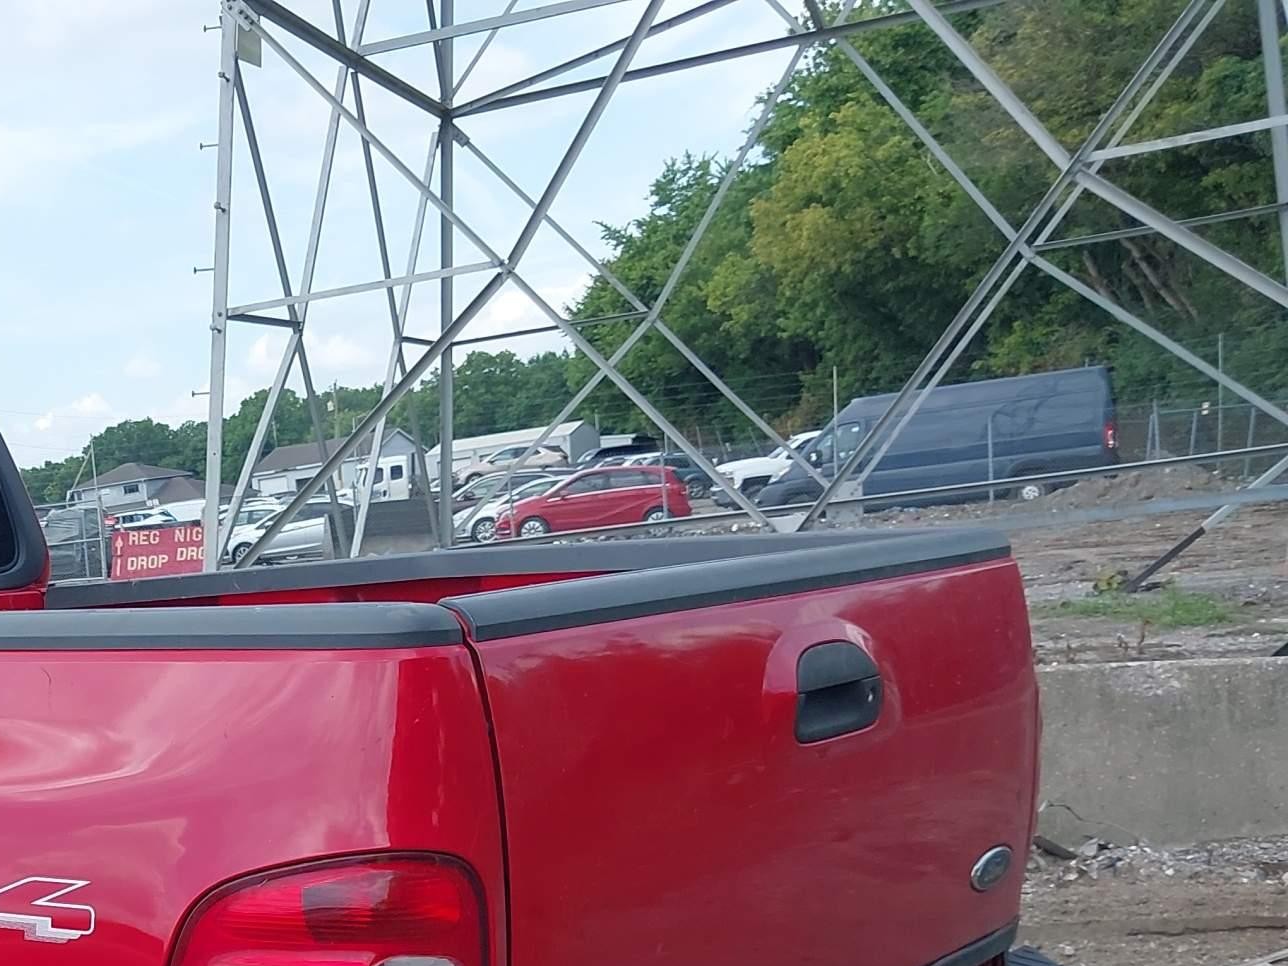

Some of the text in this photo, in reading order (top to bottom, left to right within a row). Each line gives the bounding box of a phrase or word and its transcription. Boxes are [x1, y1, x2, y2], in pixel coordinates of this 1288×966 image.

[128, 531, 160, 546] REG
[174, 527, 203, 543] NIG
[176, 546, 205, 561] DRO
[127, 554, 169, 571] DROP
